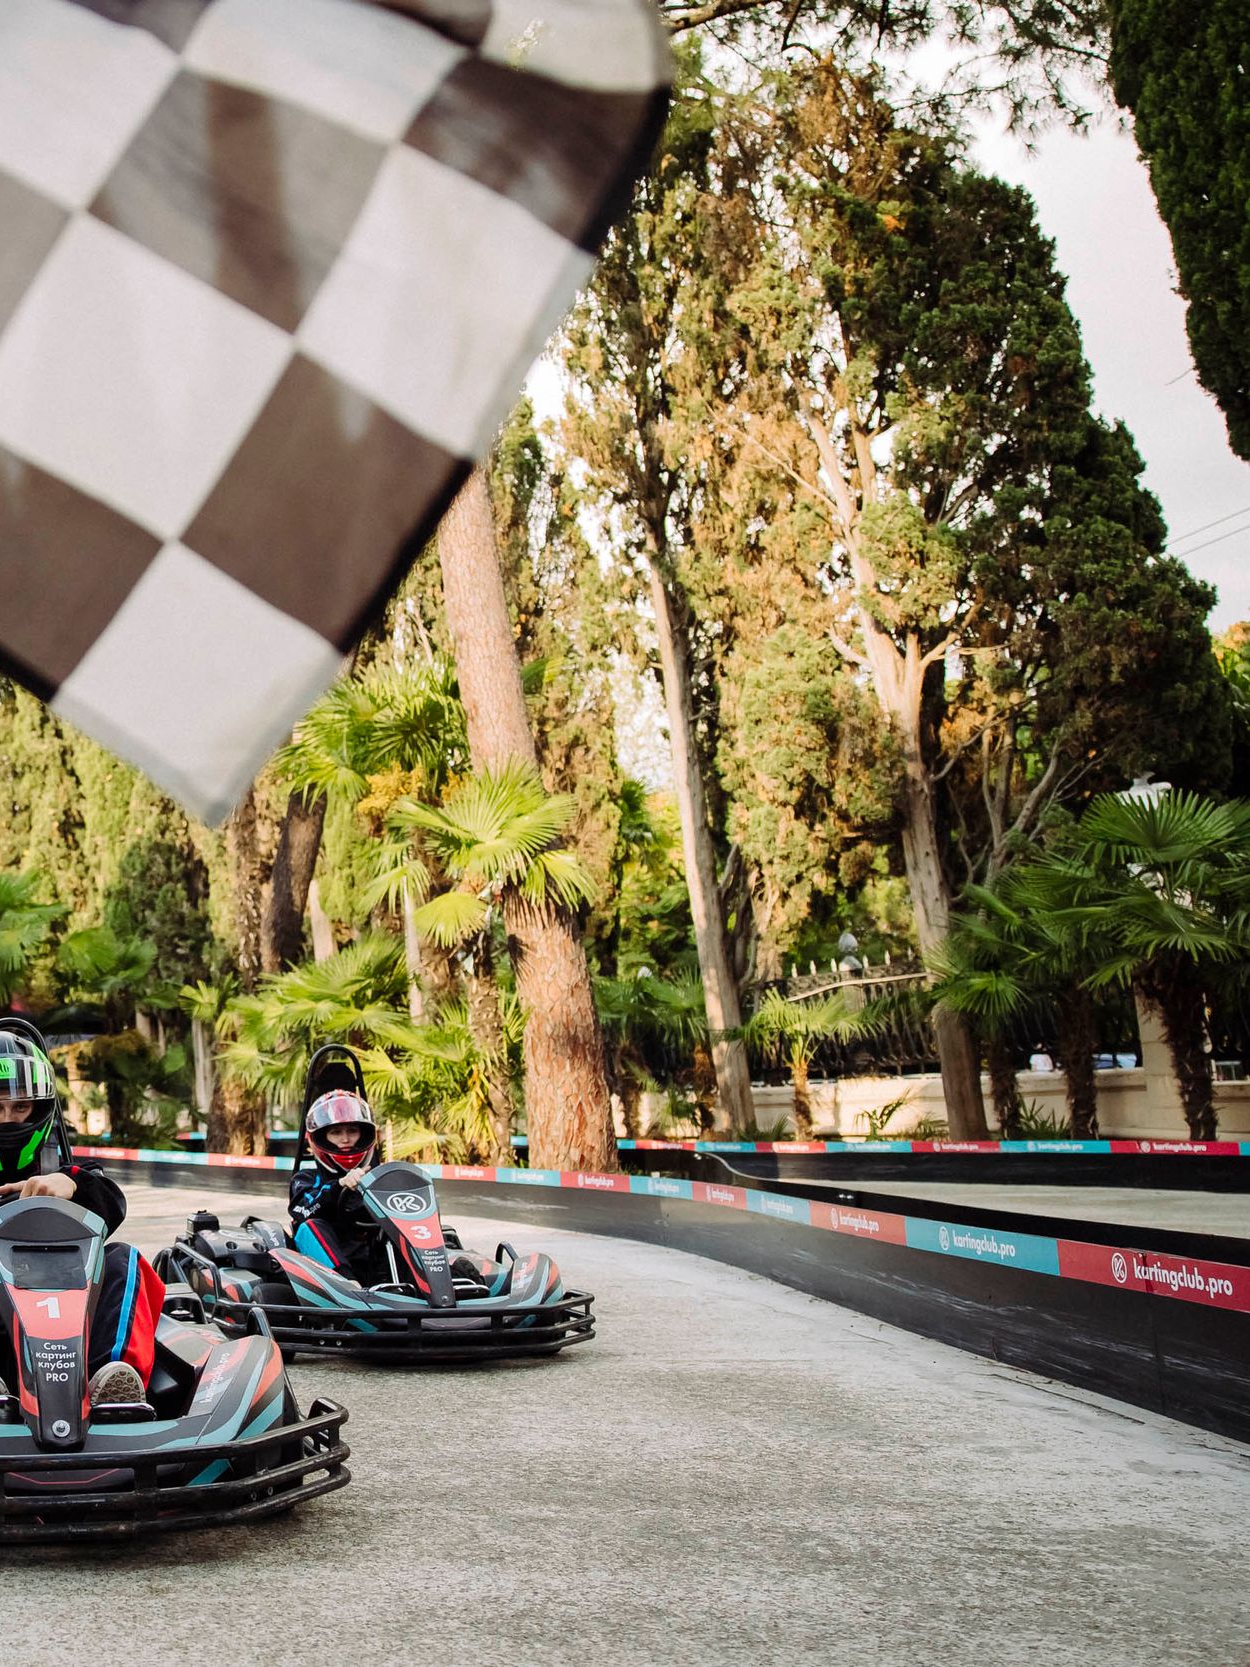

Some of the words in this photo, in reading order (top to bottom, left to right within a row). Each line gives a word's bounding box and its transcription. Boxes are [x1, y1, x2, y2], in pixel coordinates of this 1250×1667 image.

[1152, 1142, 1207, 1152] kartingclub.pro
[838, 1211, 879, 1234] kartingclub.pro
[410, 1225, 431, 1240] 3
[952, 1231, 1016, 1259] kartingclub.pro
[1132, 1257, 1233, 1298] kartingclub.pro
[36, 1296, 61, 1319] 1
[43, 1342, 67, 1351] Сеть
[35, 1351, 76, 1362] картинг
[38, 1360, 76, 1371] клубов
[46, 1372, 69, 1382] PRO
